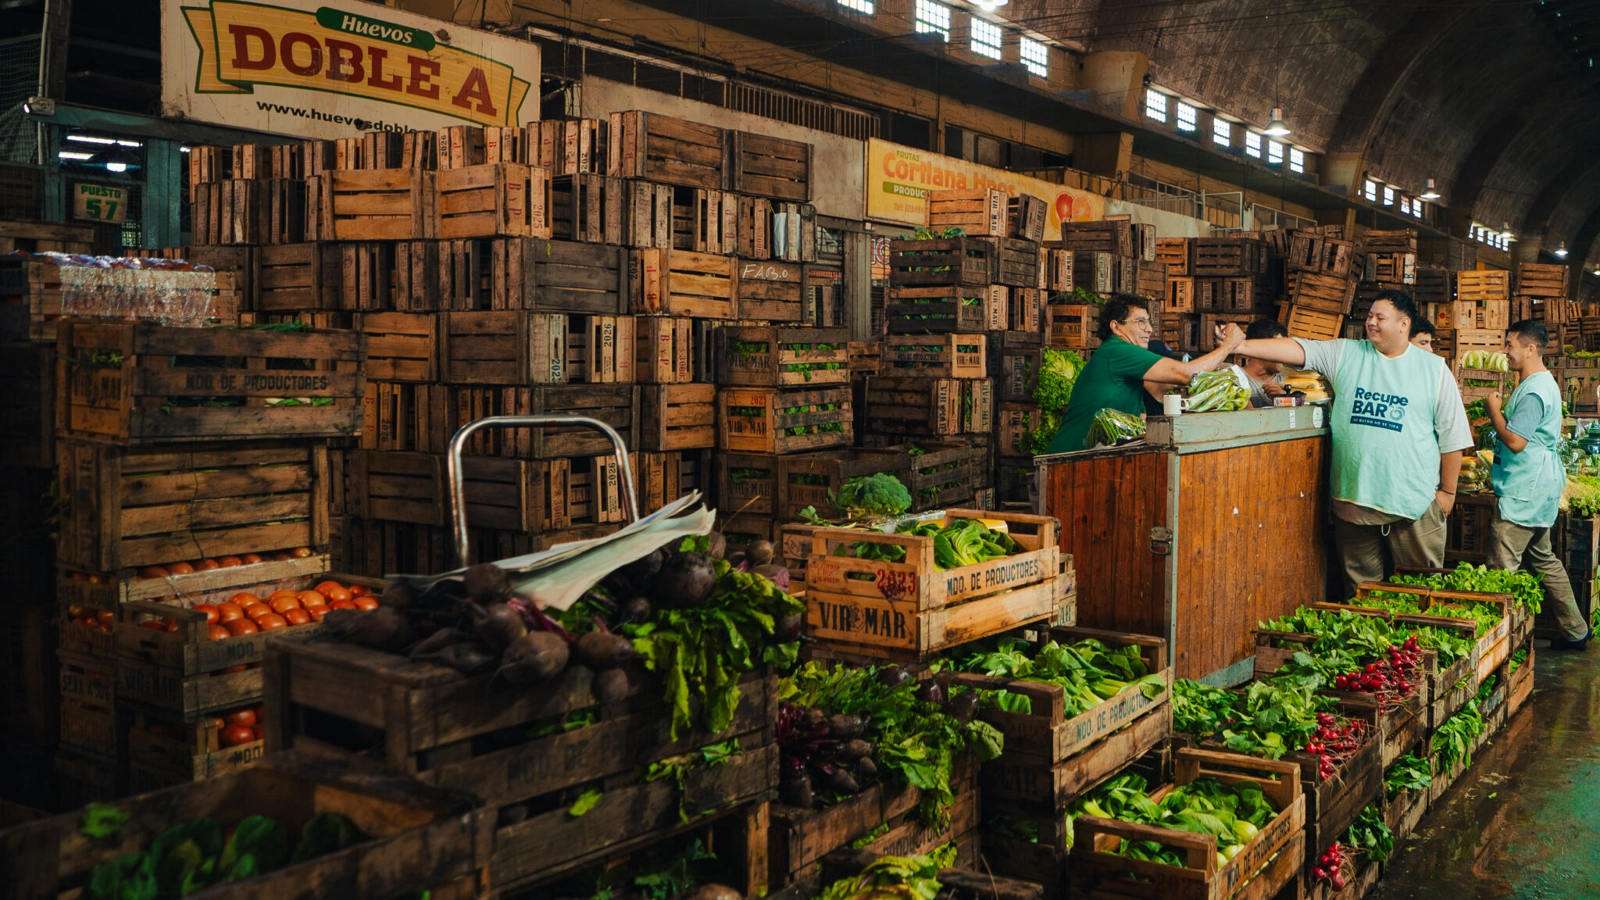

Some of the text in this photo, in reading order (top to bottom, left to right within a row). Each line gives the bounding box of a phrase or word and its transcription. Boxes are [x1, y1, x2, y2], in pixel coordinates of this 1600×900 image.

[341, 15, 413, 44] Huevos
[228, 24, 497, 117] DOBLE A
[256, 100, 417, 134] www.huevsdobl
[896, 150, 920, 162] FRUTAS
[81, 185, 121, 198] PUESTO
[508, 182, 521, 191] B
[86, 198, 117, 220] 57
[509, 208, 522, 216] P
[647, 265, 656, 273] P
[604, 323, 612, 347] 2026
[244, 374, 329, 391] PRODUCTORES
[1355, 387, 1409, 406] Recupe
[1352, 400, 1388, 418] BAR
[877, 568, 916, 594] 2023
[970, 572, 982, 591] DE
[985, 558, 1039, 588] PRODUCTORES
[1097, 711, 1106, 731] DE
[1254, 814, 1291, 865] PRODUCTORES
